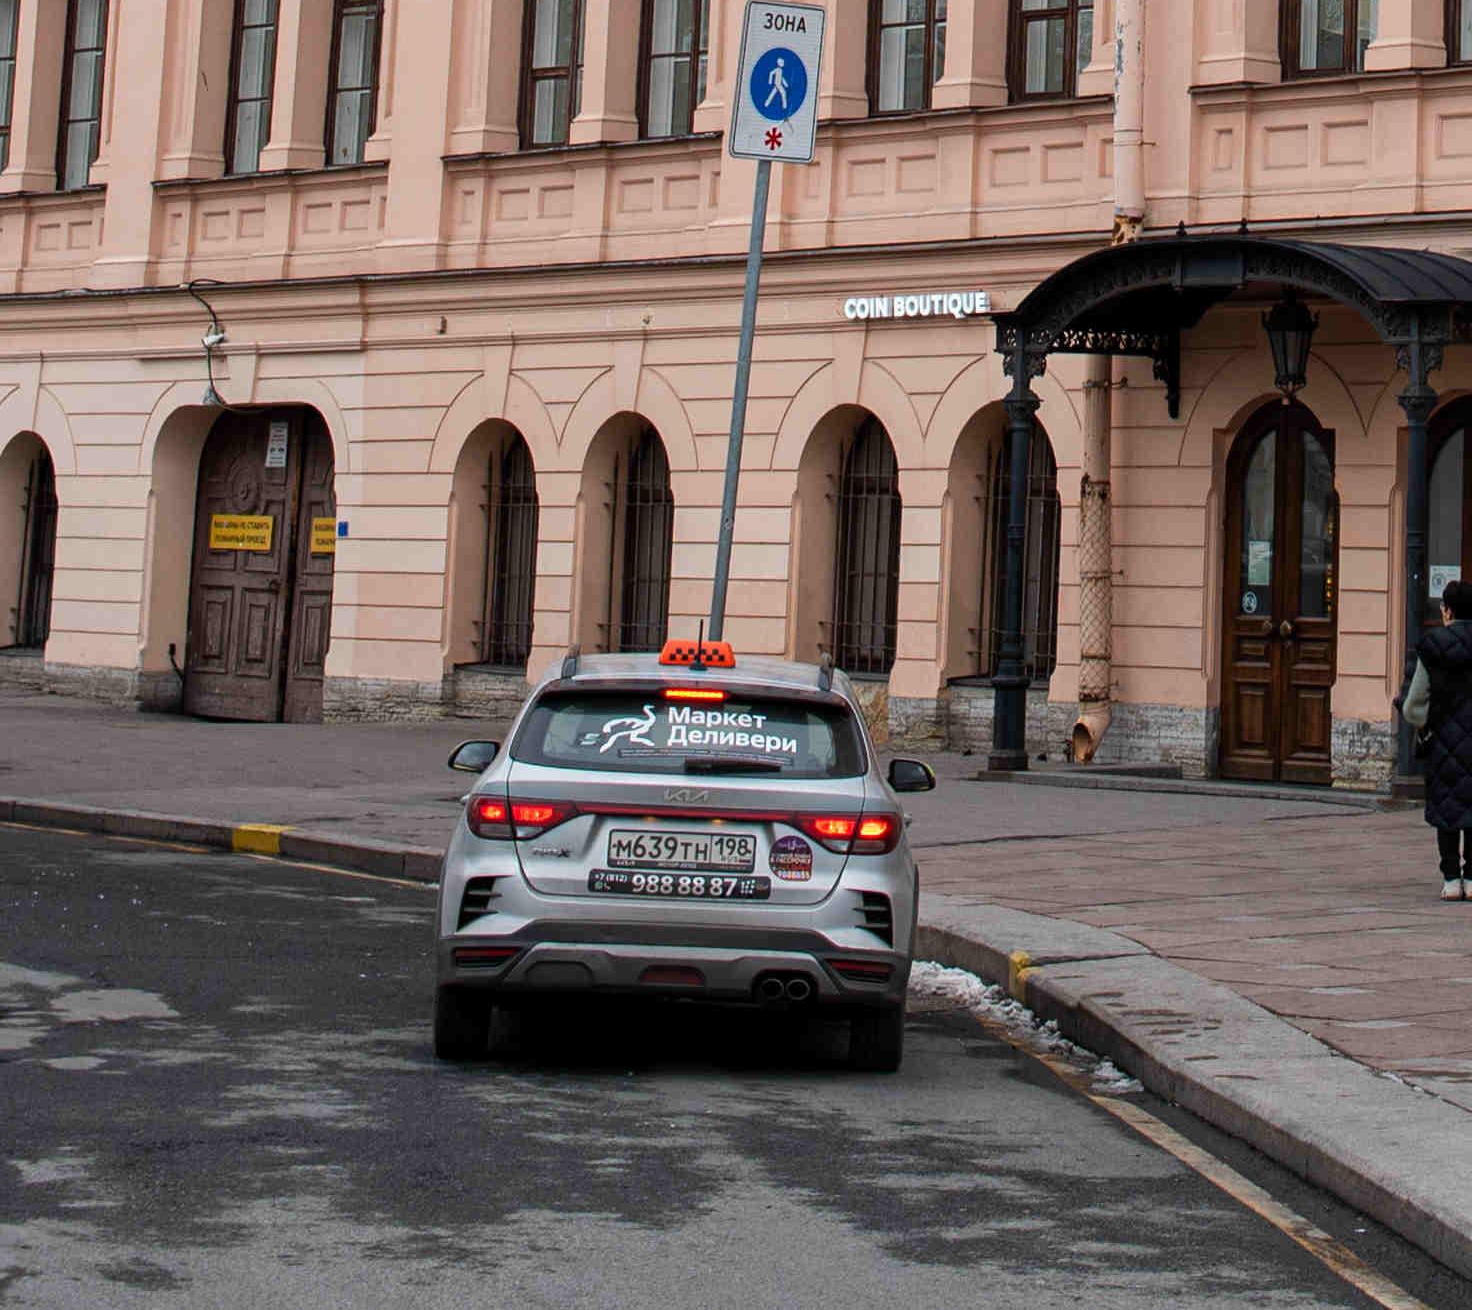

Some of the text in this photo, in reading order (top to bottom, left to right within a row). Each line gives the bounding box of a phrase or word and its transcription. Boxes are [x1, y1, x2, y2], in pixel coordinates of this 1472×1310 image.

[763, 12, 807, 34] ЗОНА
[844, 291, 990, 319] COIN BOUTIQUE
[668, 706, 767, 729] Маркет
[667, 726, 798, 754] Деливери
[615, 834, 748, 862] М639ТН 198
[632, 873, 674, 895] 988
[678, 876, 705, 896] 88
[710, 877, 737, 897] 87
